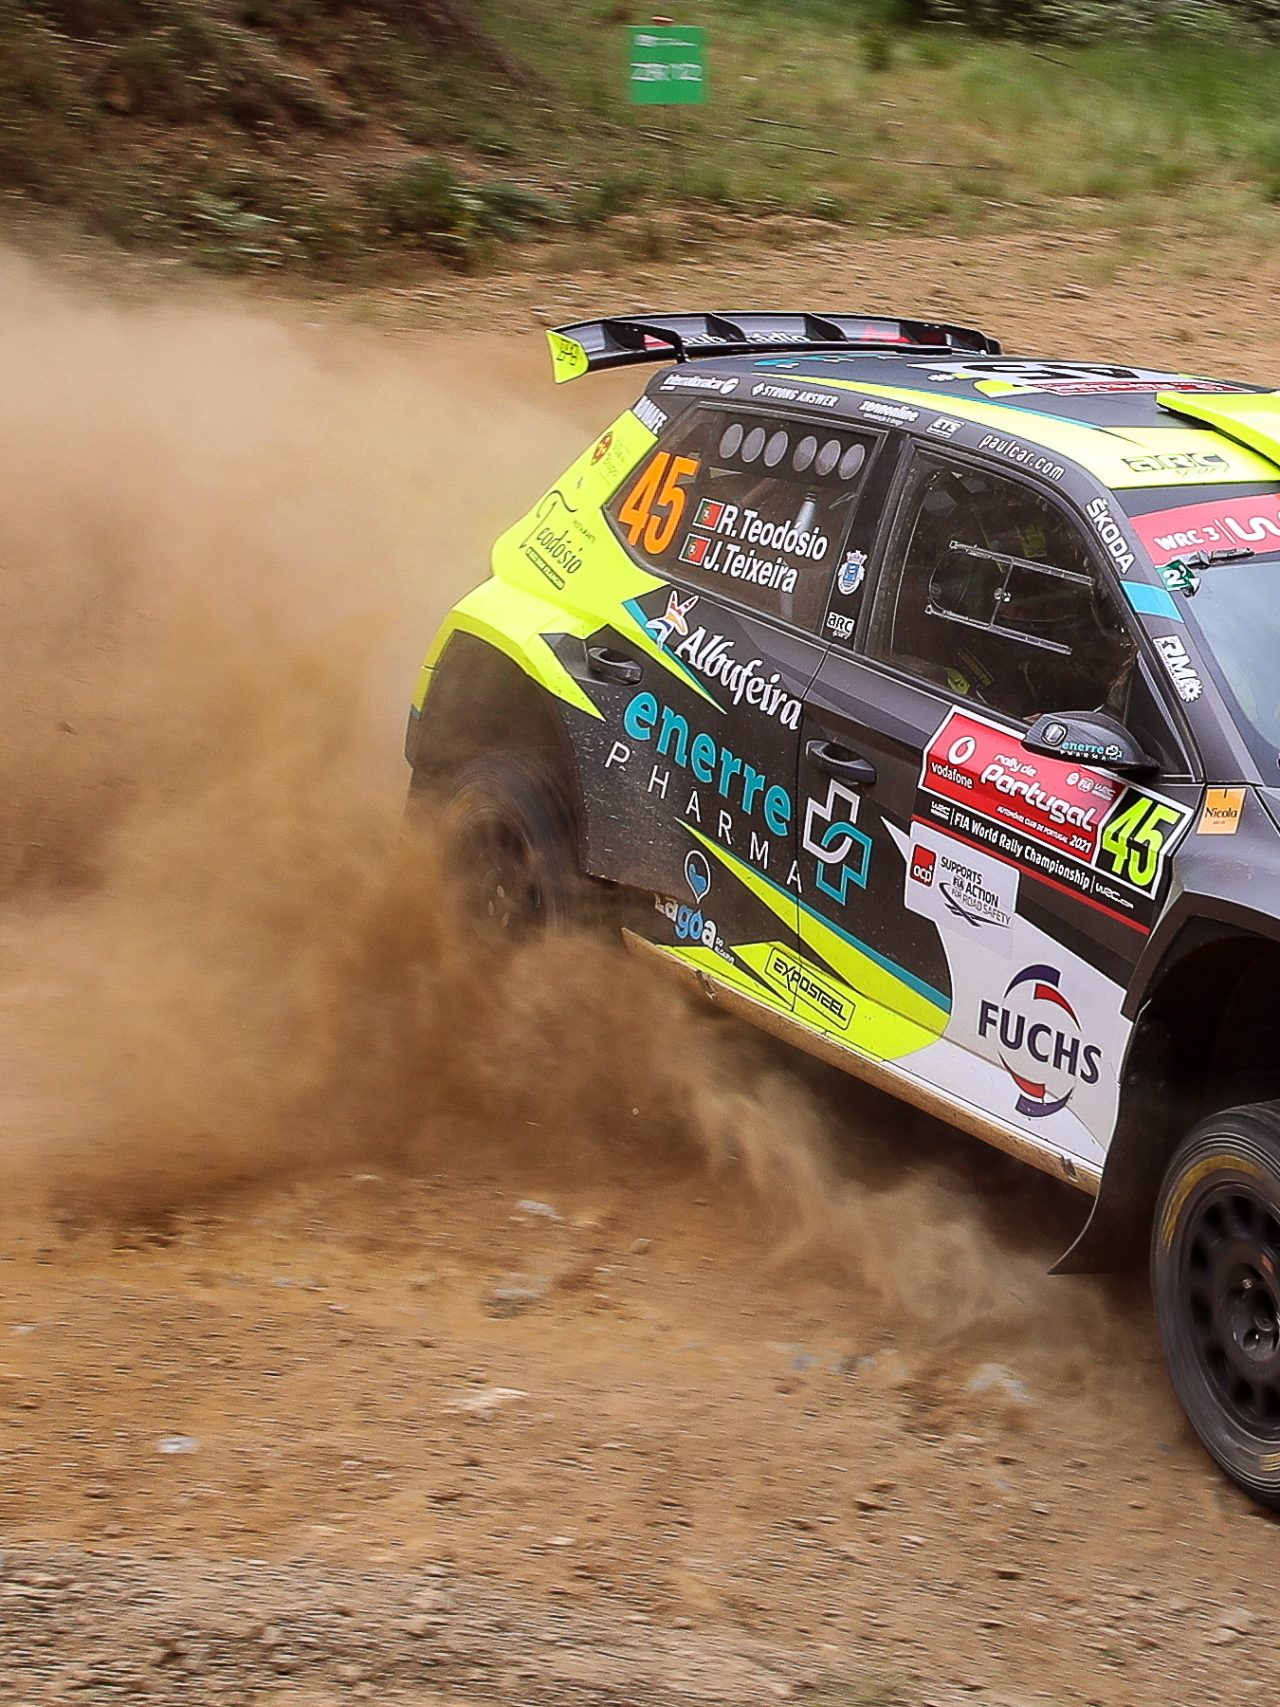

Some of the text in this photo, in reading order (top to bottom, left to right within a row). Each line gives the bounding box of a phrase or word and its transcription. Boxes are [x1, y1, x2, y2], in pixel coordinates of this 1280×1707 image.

[762, 385, 839, 408] STRONG ANSWER
[979, 434, 1066, 481] paulcar.com
[617, 450, 699, 554] 45
[1086, 498, 1136, 574] ŠKODA
[1154, 531, 1205, 551] WRC
[1203, 526, 1221, 542] 3
[675, 627, 802, 730] Albufeira
[624, 692, 792, 837] enerre
[994, 754, 1038, 779] rally de
[1061, 741, 1105, 754] enerre
[931, 762, 973, 789] vodafone
[981, 763, 1097, 833] Portugal
[1205, 807, 1238, 819] Nicola
[954, 812, 1091, 892] FIA World Rally Championship
[1069, 834, 1092, 854] 2021
[1102, 796, 1182, 887] 45
[940, 855, 983, 884] SUPPORTS
[961, 890, 984, 912] ROAD
[983, 902, 1012, 926] SAFETY
[964, 881, 999, 908] ACTION
[771, 953, 850, 1022] EXPOSTEEL
[978, 999, 1103, 1086] FUCHS
